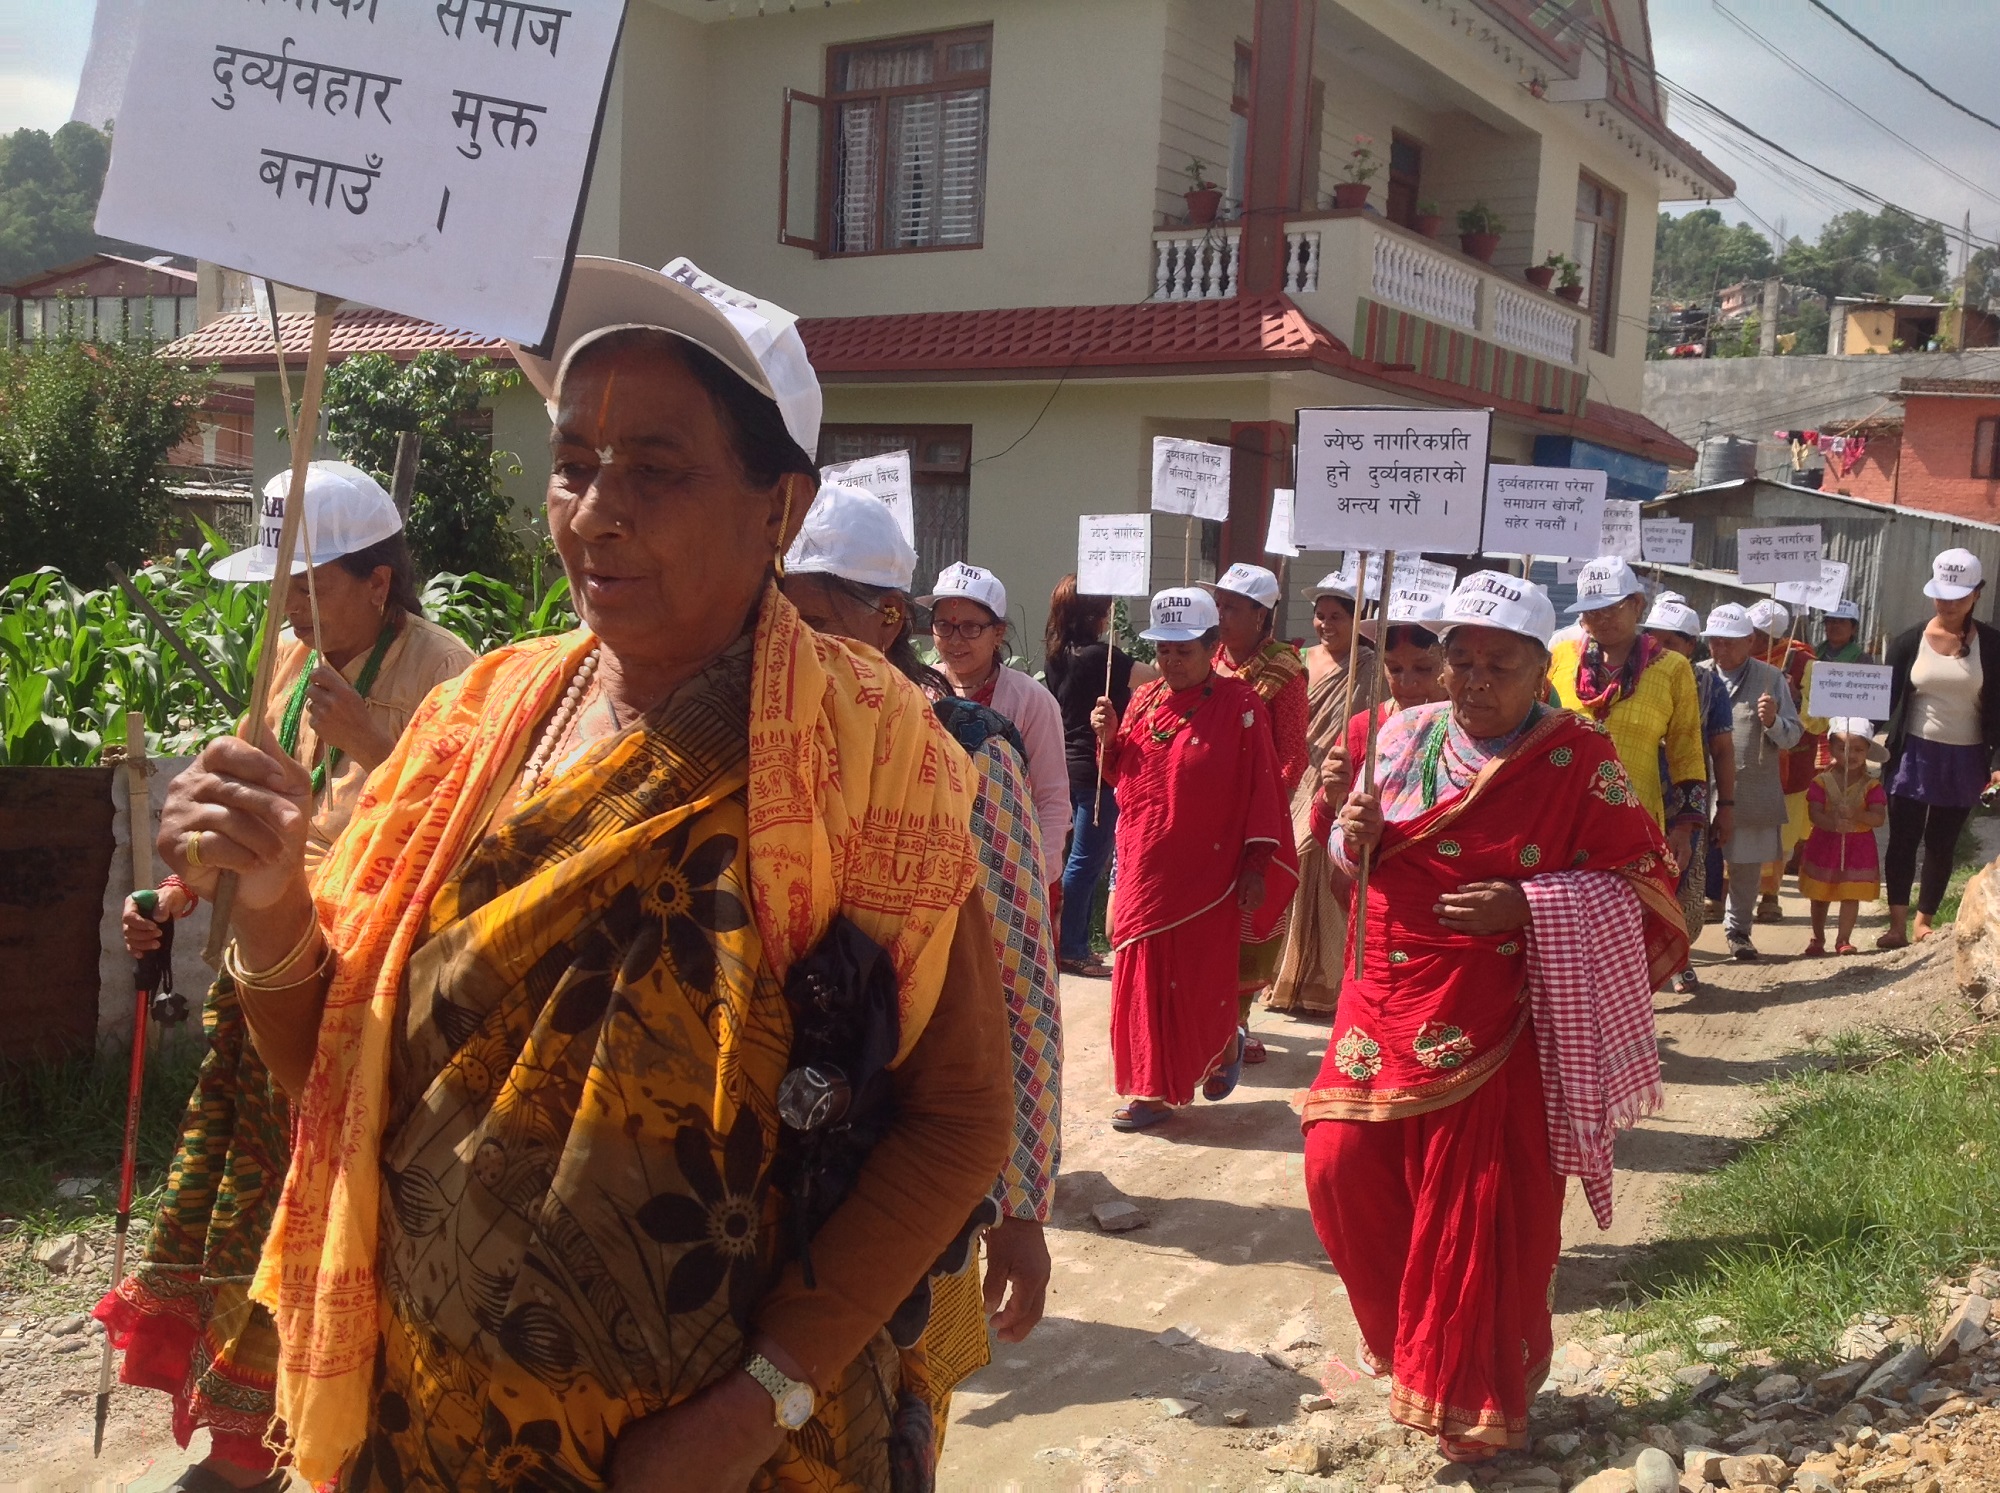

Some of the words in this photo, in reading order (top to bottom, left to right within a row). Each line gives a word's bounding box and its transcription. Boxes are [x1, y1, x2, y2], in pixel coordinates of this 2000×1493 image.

[436, 0, 572, 58] समाज
[211, 37, 403, 125] दुर्व्यवहार
[451, 89, 548, 160] मुक्त
[258, 147, 384, 216] बनाउँ
[1324, 428, 1365, 451] ज्येष्ठ
[1373, 427, 1472, 451] नागरिकप्रति
[1326, 460, 1351, 488] हुने
[1369, 459, 1467, 489] दुर्व्यवहारको
[1497, 475, 1560, 492] दुर्व्यवहारमा
[1565, 478, 1594, 493] परेमा
[1337, 496, 1380, 514] अन्त्य
[1503, 498, 1547, 510] समाधान
[1504, 514, 1530, 529] सहेर
[1778, 532, 1814, 545] नागरिक
[1774, 550, 1798, 560] देवता
[1157, 597, 1191, 610] WEAAD
[1161, 612, 1183, 624] 2017
